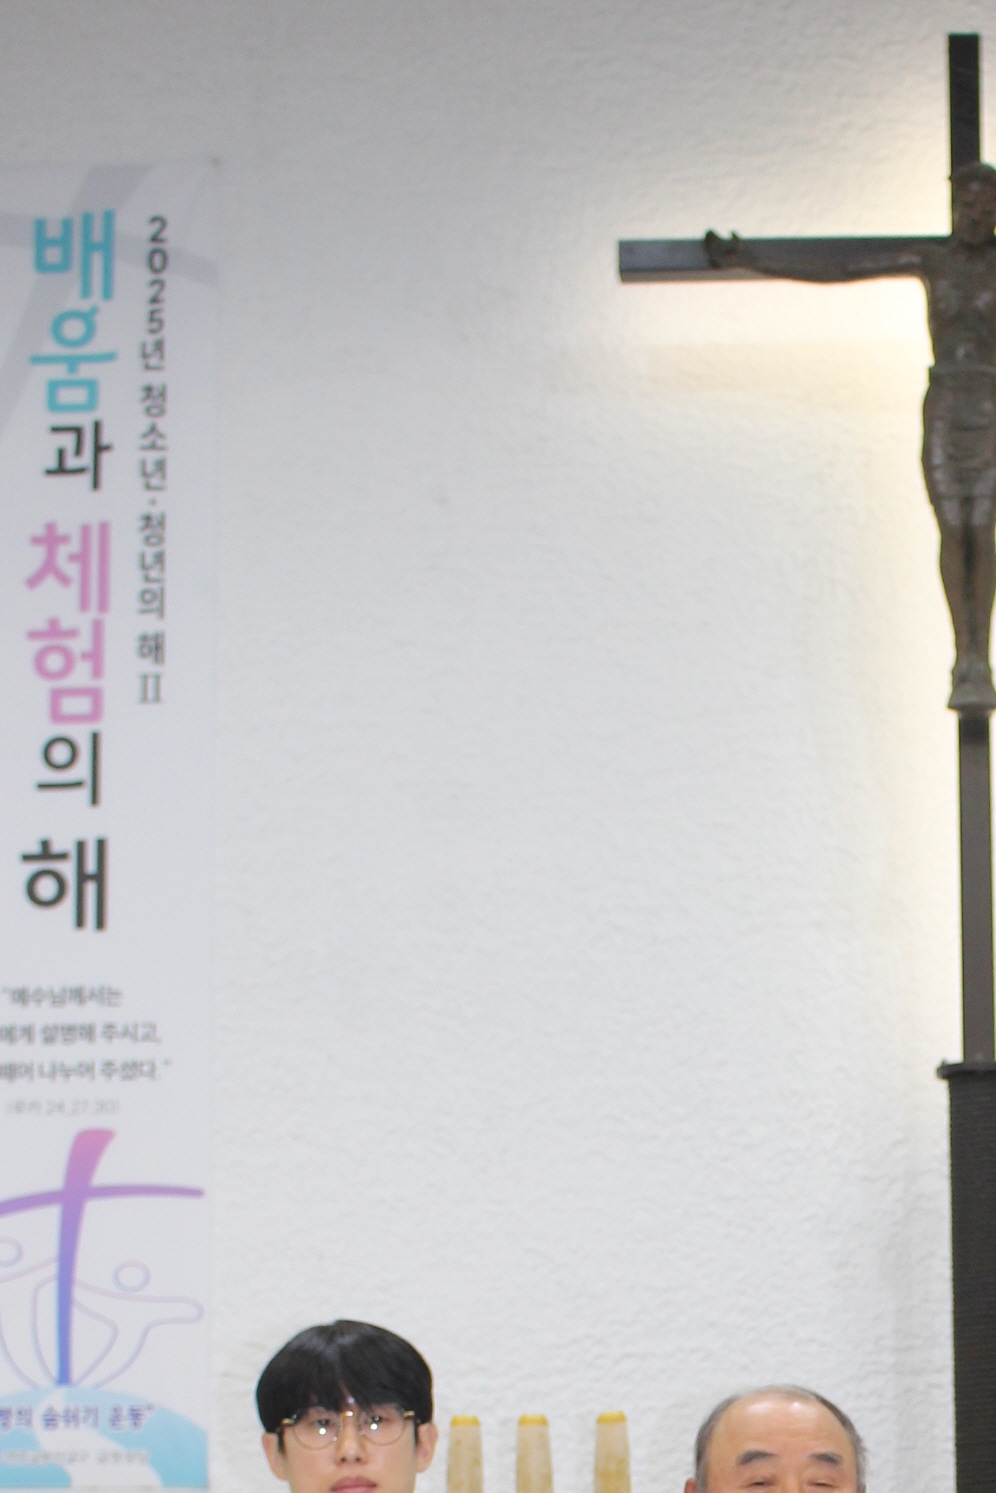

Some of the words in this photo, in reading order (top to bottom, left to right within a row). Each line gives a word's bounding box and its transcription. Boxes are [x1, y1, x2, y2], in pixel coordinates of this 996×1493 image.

[29, 208, 118, 491] 배움과
[141, 214, 168, 371] 2025년
[25, 520, 111, 808] 체험의
[138, 631, 165, 665] 해
[21, 837, 108, 932] 해
